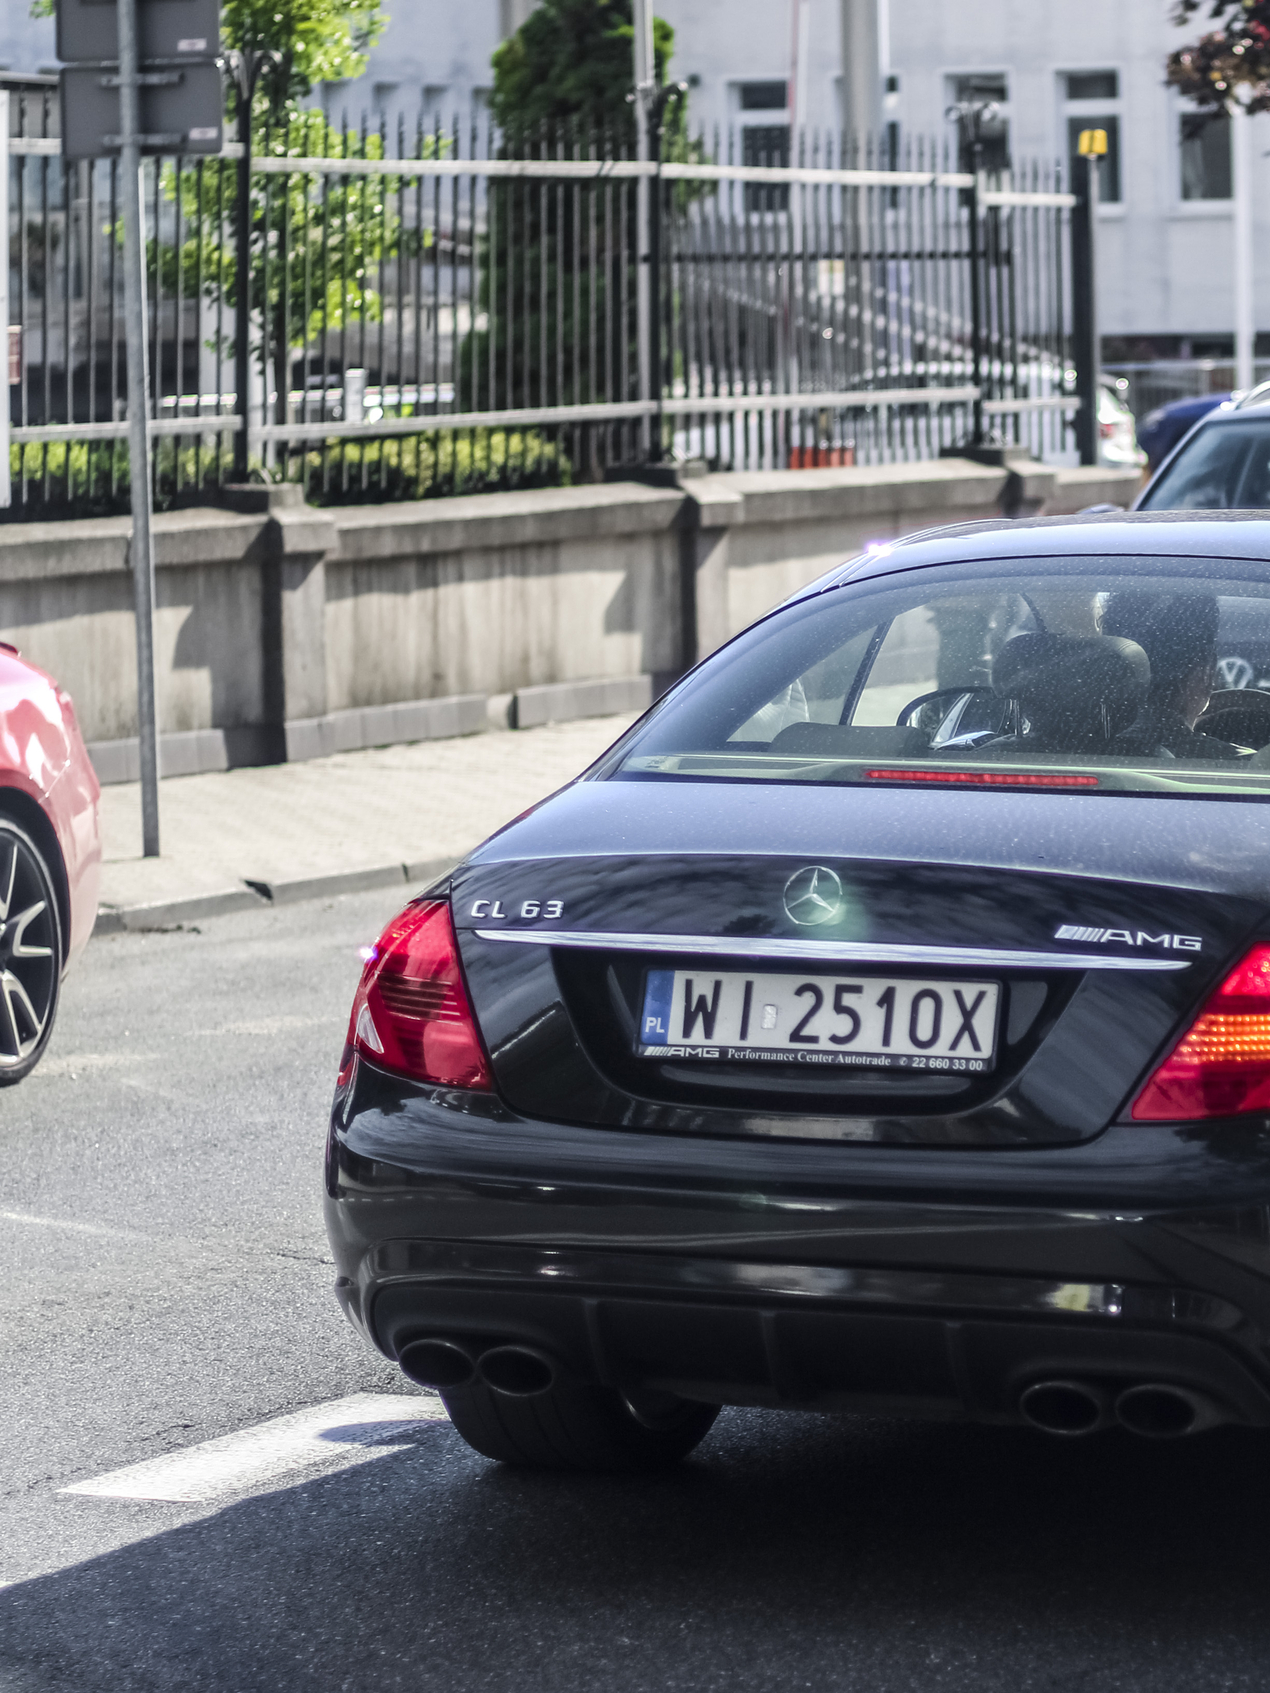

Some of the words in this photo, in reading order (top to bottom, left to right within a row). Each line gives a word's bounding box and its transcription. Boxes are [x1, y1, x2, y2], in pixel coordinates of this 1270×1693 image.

[470, 900, 507, 919] CL
[520, 900, 565, 919] 63
[1099, 928, 1203, 951] AMG
[644, 1016, 665, 1033] PL
[681, 978, 755, 1041] WI
[788, 982, 988, 1053] 2510X
[667, 1045, 720, 1059] AMG
[727, 1047, 795, 1062] Performance
[797, 1051, 835, 1064] Center
[836, 1053, 891, 1066] Autotrade
[911, 1056, 927, 1068] 22
[928, 1057, 950, 1069] 660
[952, 1058, 967, 1070] 33
[968, 1059, 984, 1071] 00
